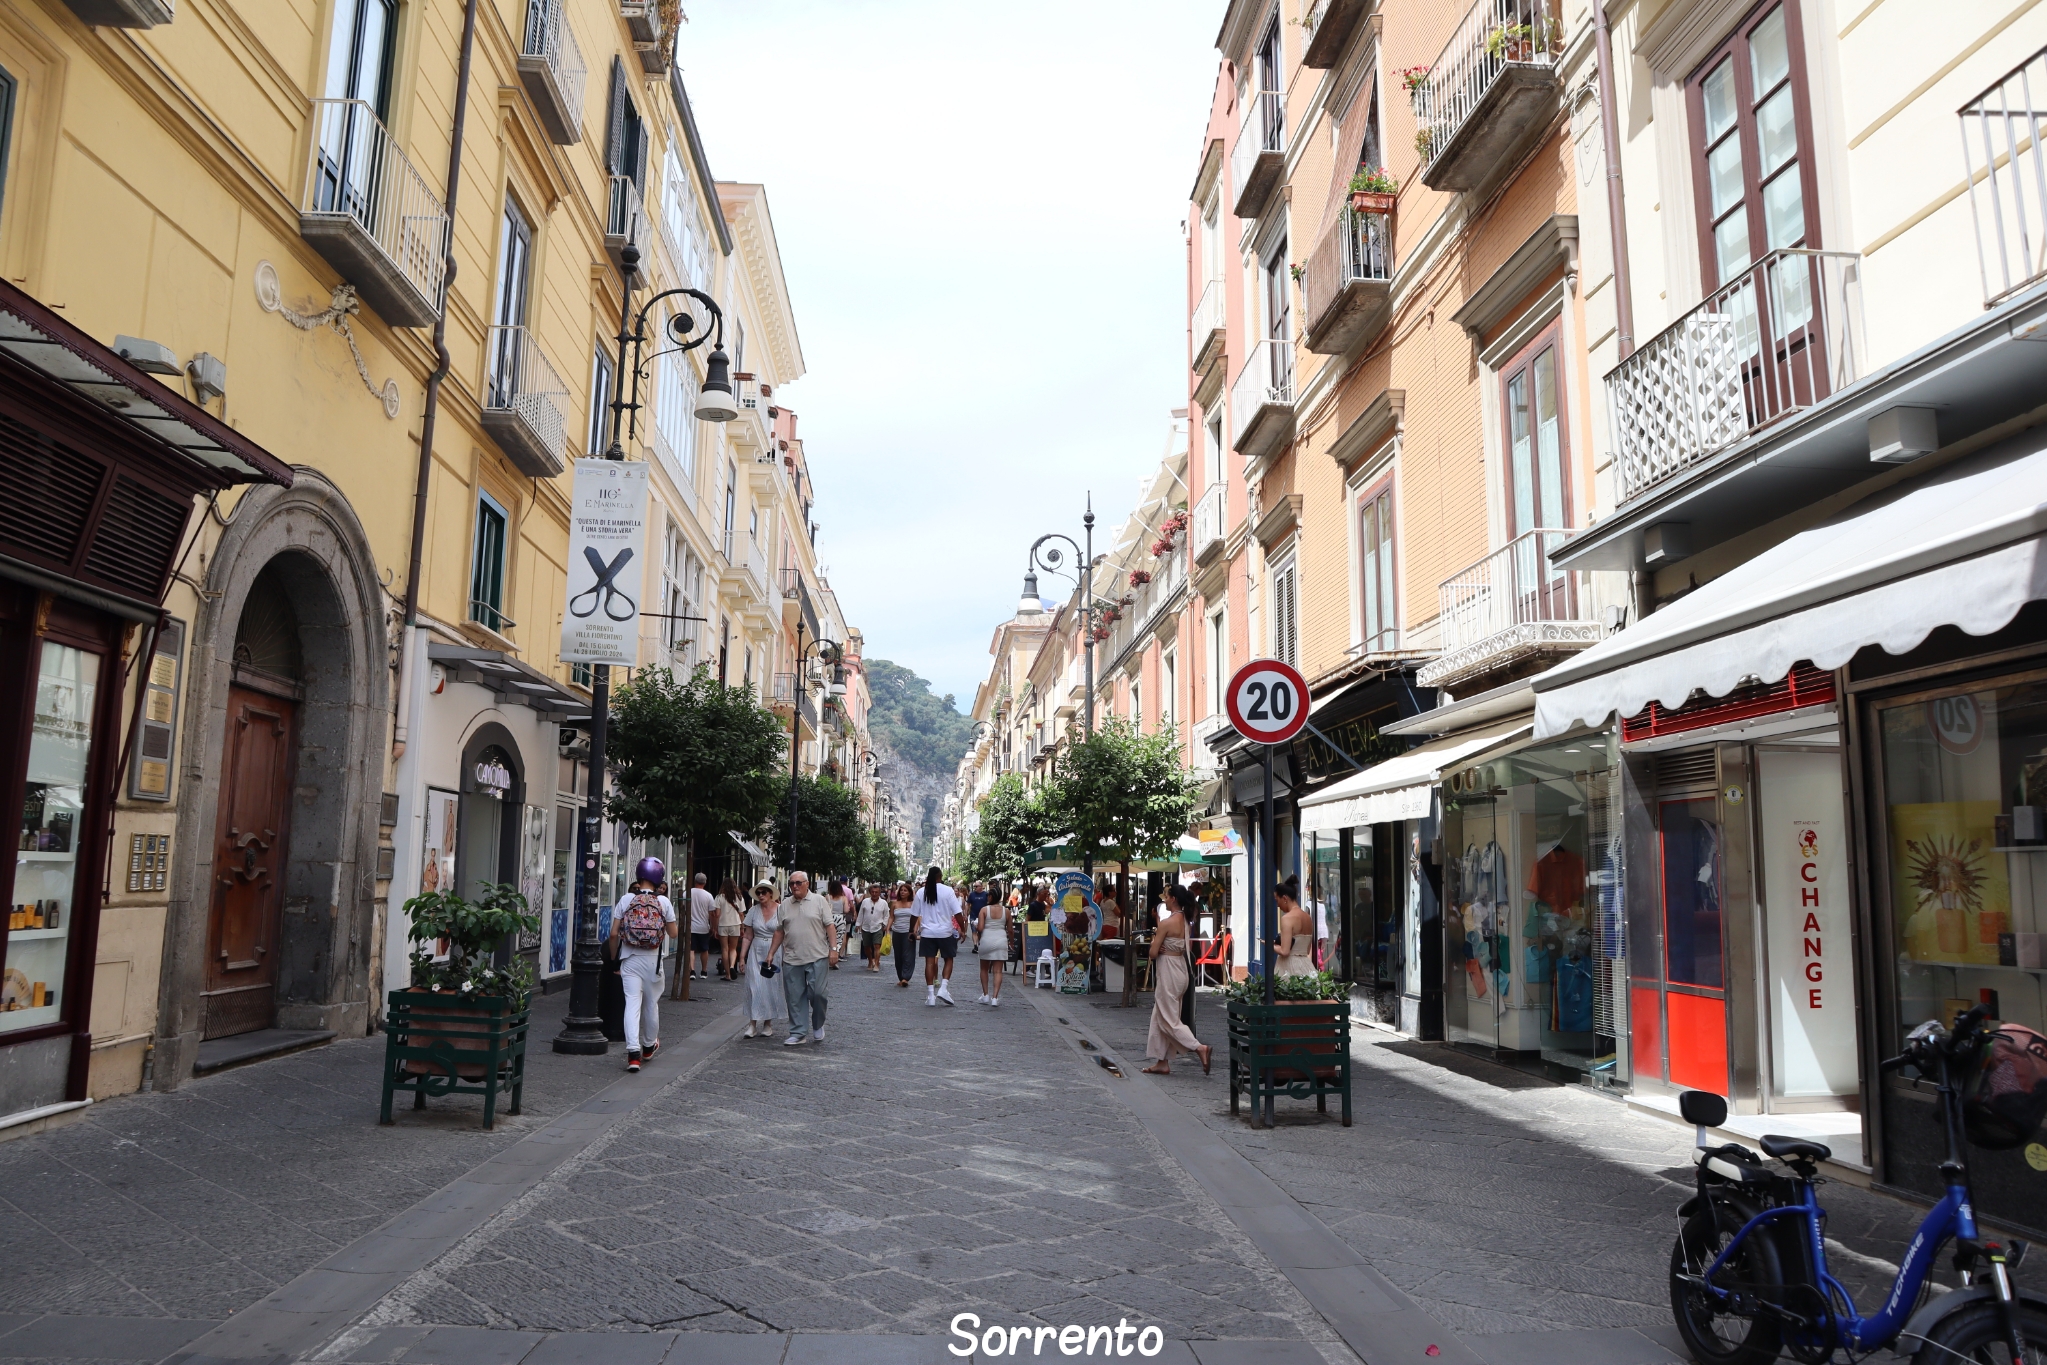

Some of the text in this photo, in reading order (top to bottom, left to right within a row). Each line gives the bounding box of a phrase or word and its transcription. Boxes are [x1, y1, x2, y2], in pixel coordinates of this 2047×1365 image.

[612, 519, 641, 527] MARINELLA
[598, 526, 618, 534] STORIA
[585, 624, 614, 632] SORRENTO
[591, 632, 623, 640] FIORENTINO
[1247, 682, 1291, 720] 20
[1308, 718, 1381, 770] A. DI LEVA
[1800, 862, 1823, 1009] CHANGE
